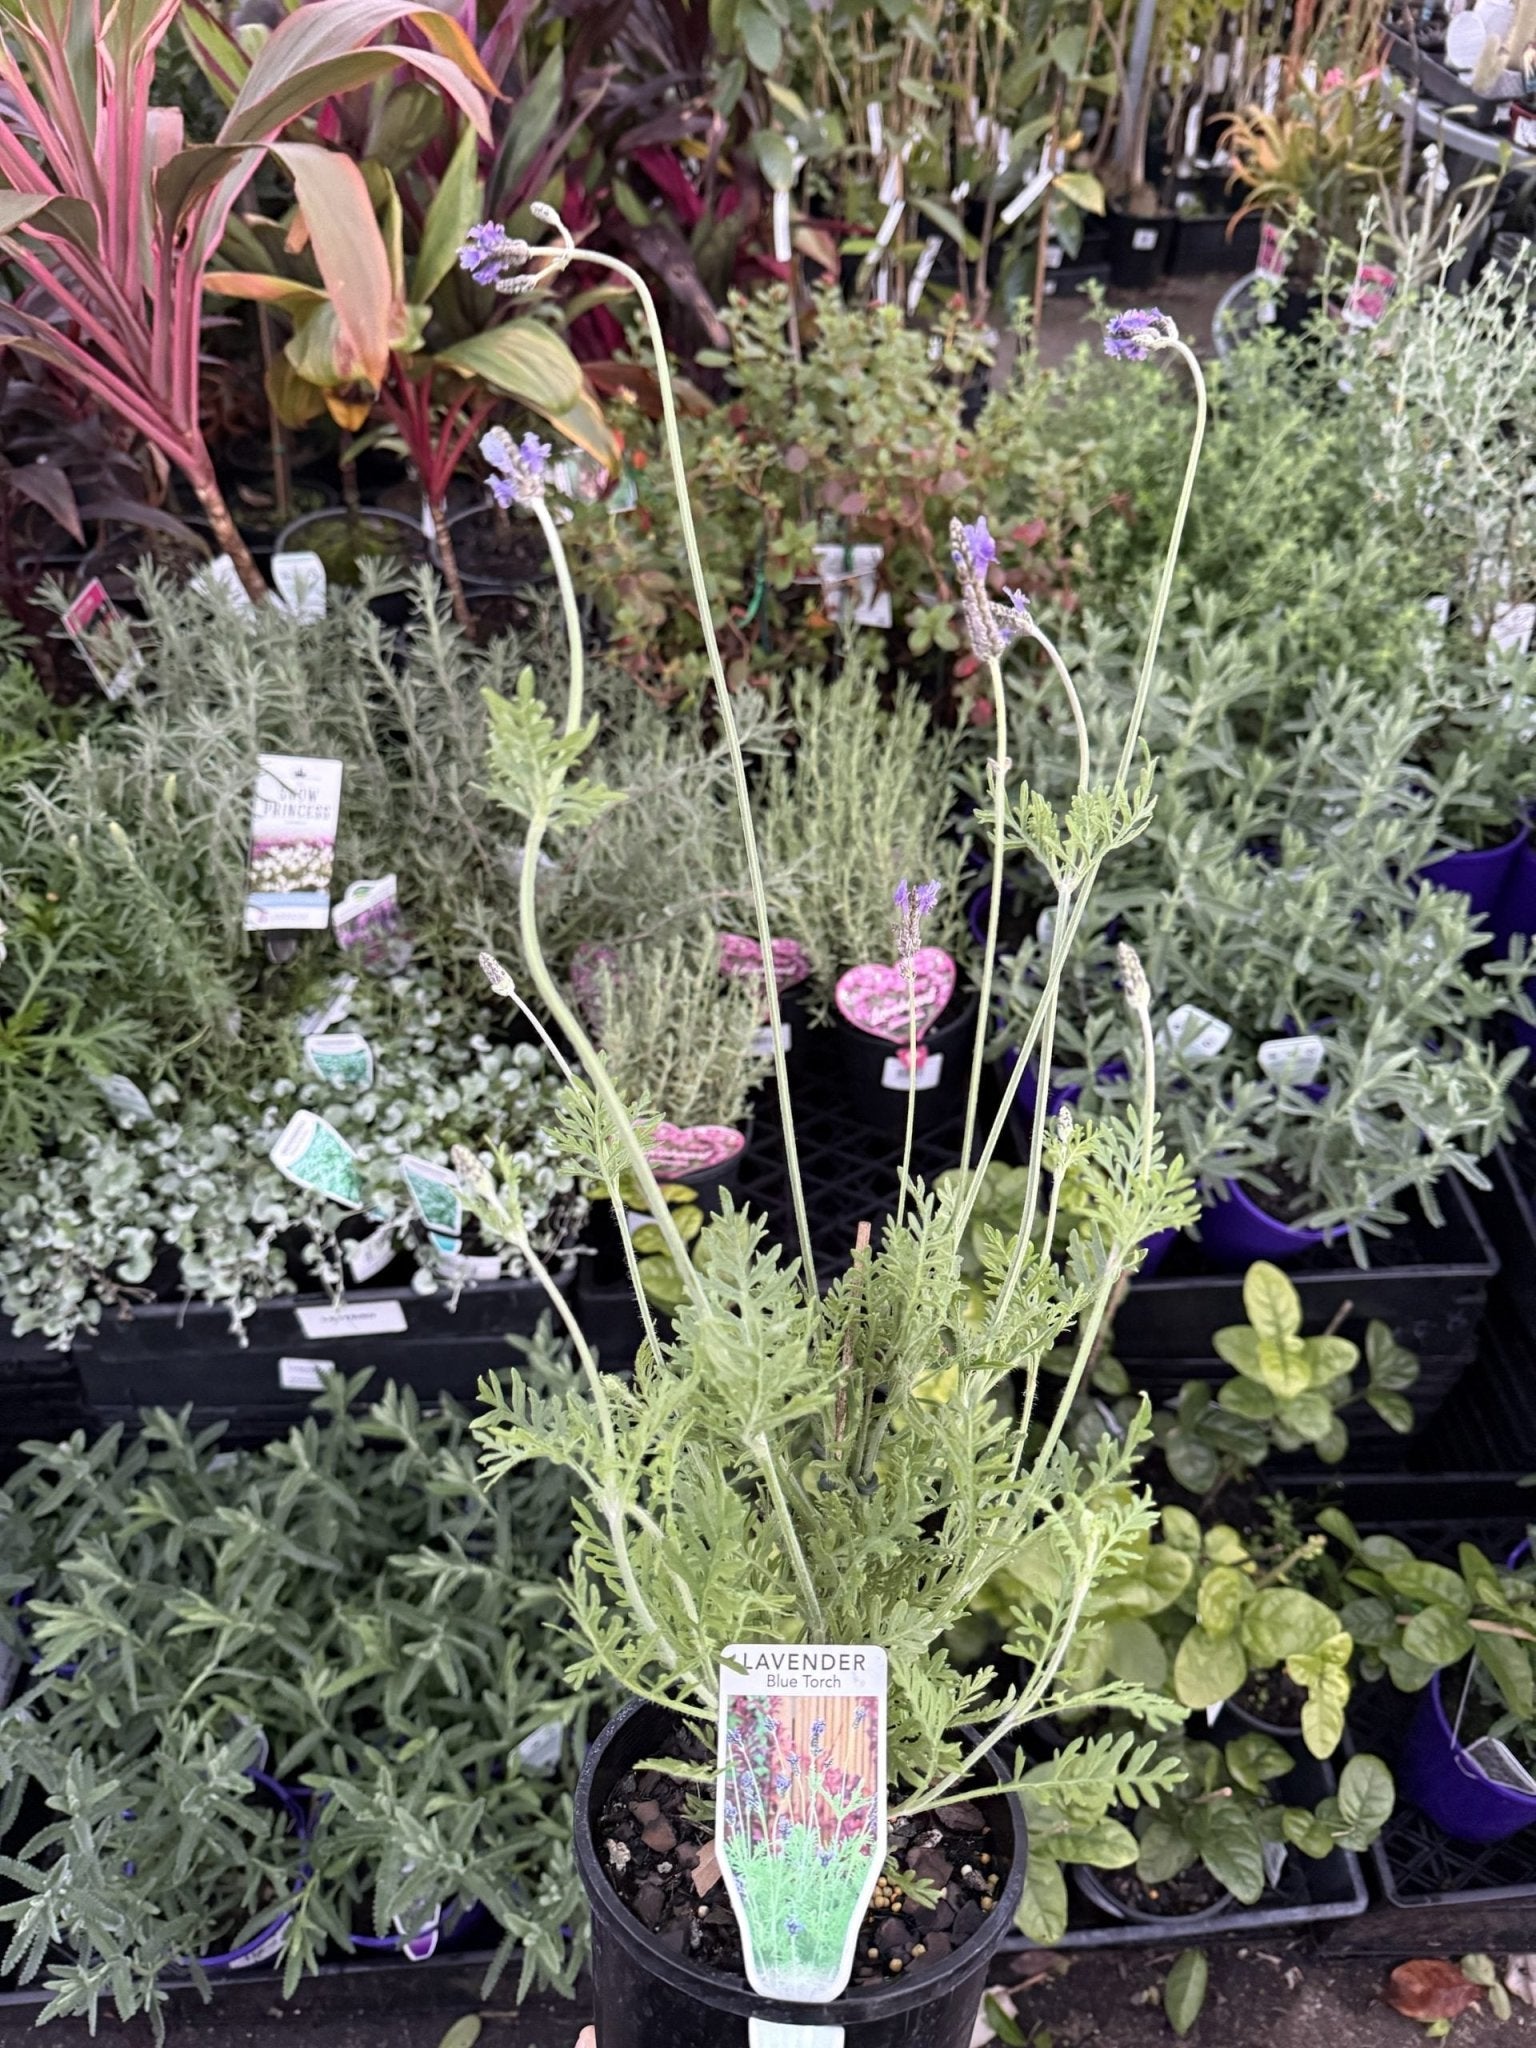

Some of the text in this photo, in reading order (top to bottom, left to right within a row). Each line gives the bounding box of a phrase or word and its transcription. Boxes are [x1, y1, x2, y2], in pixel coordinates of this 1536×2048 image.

[264, 802, 332, 820] PRINCESS
[743, 1653, 866, 1671] LAVENDER
[766, 1674, 842, 1688] Blue Torch
